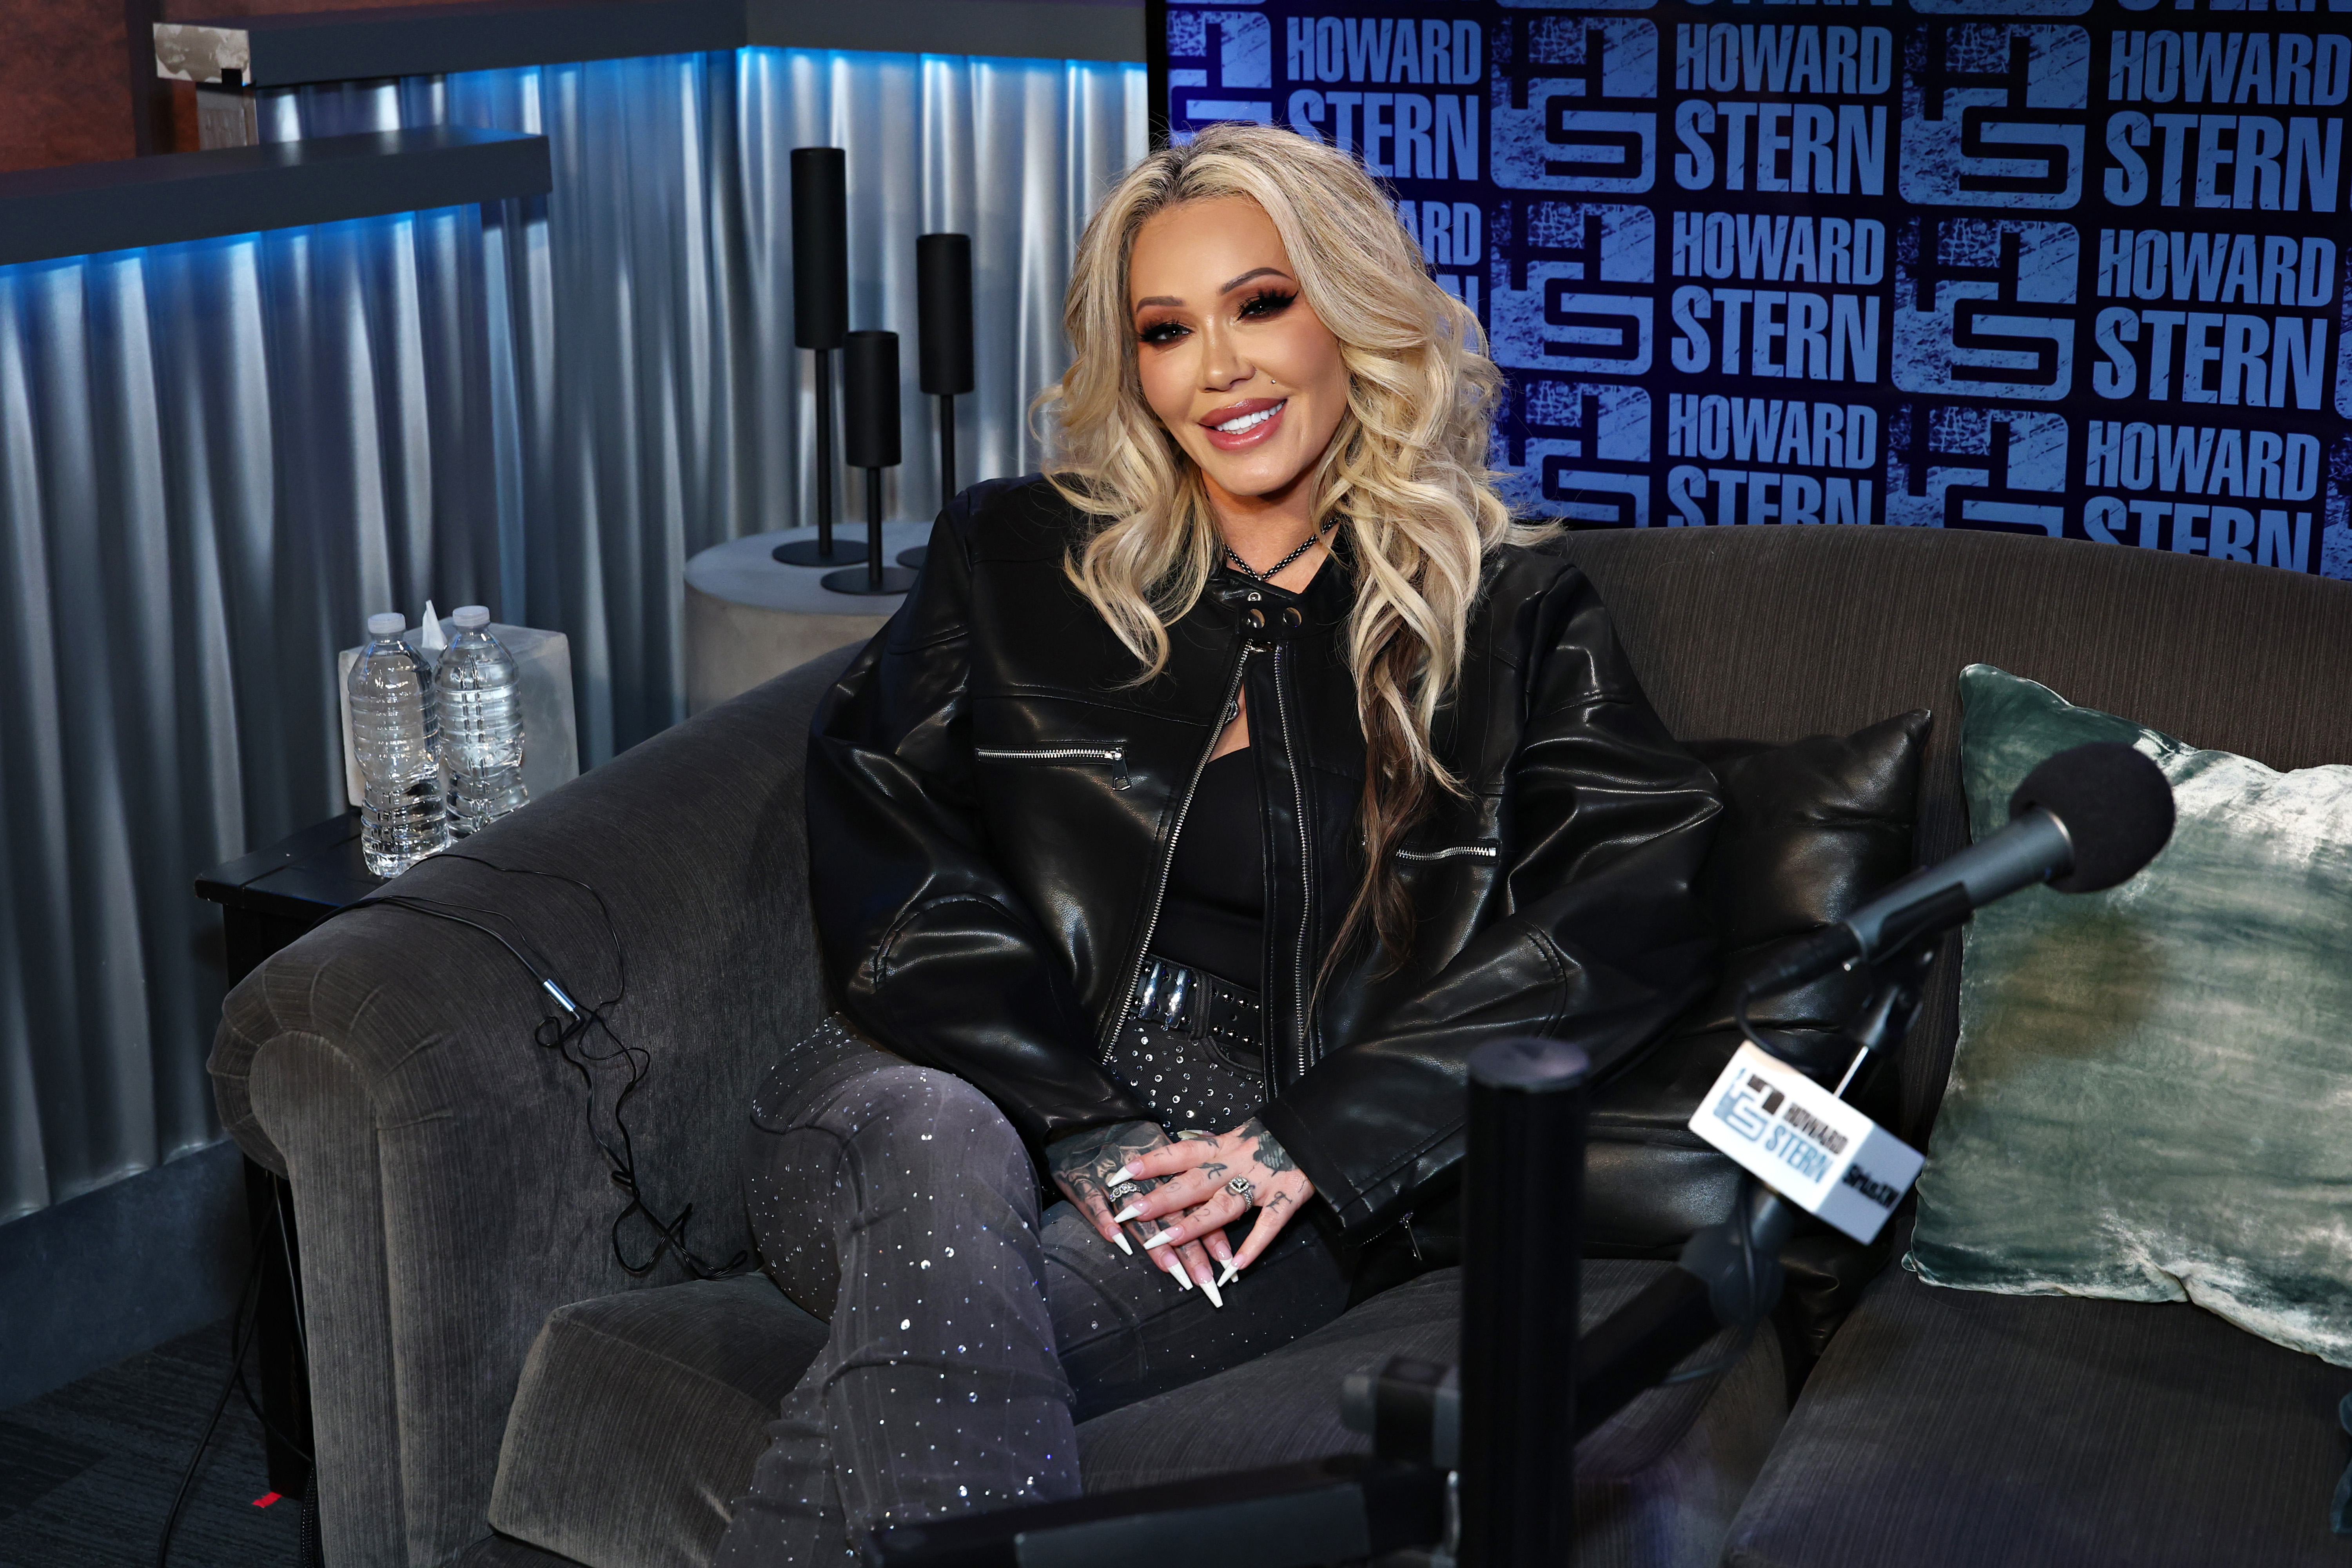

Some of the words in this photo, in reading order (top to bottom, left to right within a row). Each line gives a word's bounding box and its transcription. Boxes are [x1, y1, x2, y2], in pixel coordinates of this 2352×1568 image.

[1287, 16, 1481, 84] HOWARD
[1676, 24, 1891, 94] HOWARD
[2109, 31, 2351, 105] HOWARD
[1288, 89, 1479, 180] STERN
[1675, 100, 1887, 195] STERN
[2104, 111, 2343, 212] STERN
[1672, 211, 1885, 285] HOWARD
[2098, 229, 2336, 306] HOWARD
[1671, 285, 1880, 383] STERN
[2093, 307, 2327, 410] STERN
[1668, 393, 1877, 469] HOWARD
[2085, 420, 2320, 501] HOWARD
[1668, 465, 1872, 527] STERN
